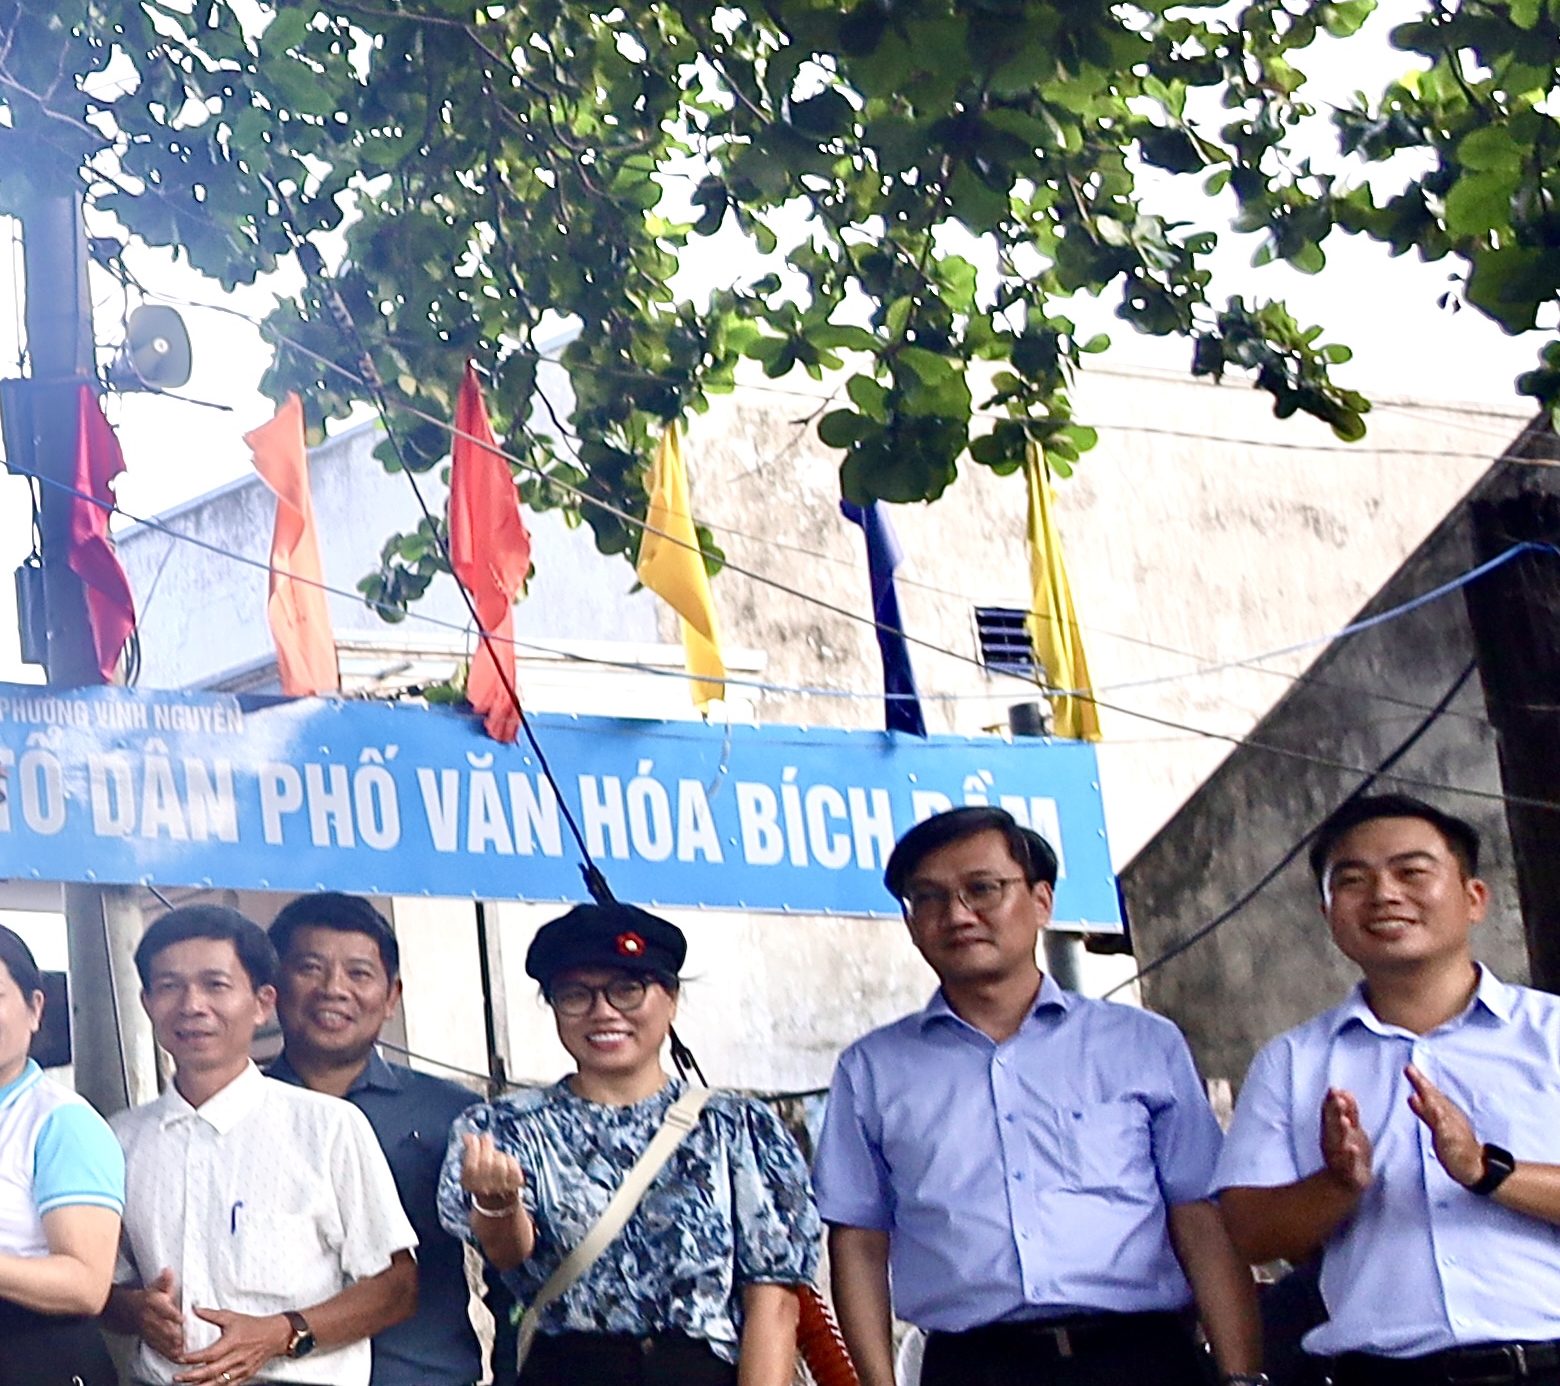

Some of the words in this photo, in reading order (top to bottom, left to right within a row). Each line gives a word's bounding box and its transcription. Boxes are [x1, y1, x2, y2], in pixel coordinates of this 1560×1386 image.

[154, 701, 244, 734] NGUYÊN
[86, 736, 240, 844] DÂN
[258, 742, 401, 851] PHỐ
[415, 750, 564, 857] VĂN
[577, 758, 725, 865] HÓA
[735, 765, 896, 870] BÍCH
